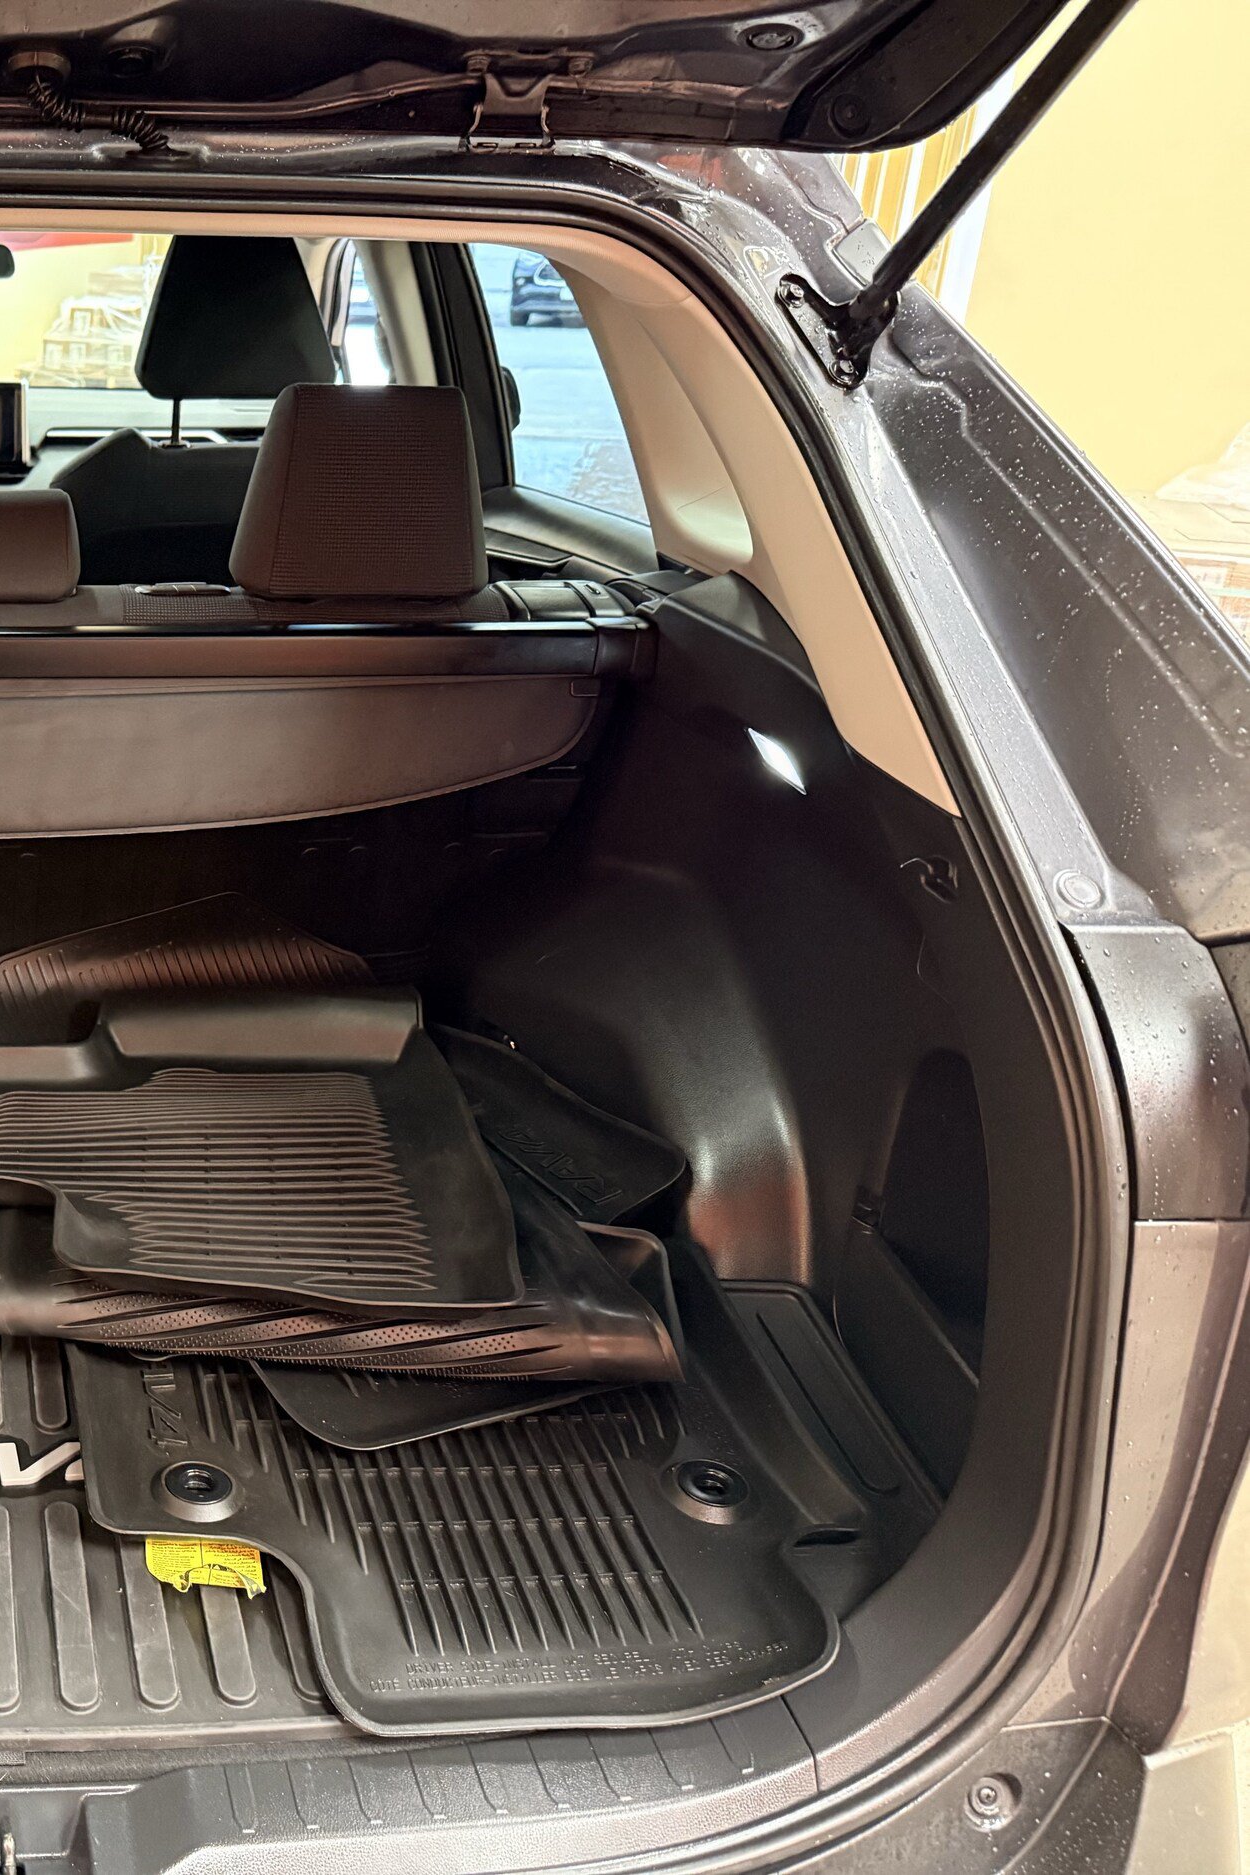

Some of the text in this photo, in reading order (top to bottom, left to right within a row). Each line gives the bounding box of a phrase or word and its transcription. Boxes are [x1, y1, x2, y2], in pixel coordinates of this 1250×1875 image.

[495, 1129, 623, 1206] RAV4
[405, 1662, 454, 1675] DRIVER
[593, 1650, 653, 1665] SECUREL
